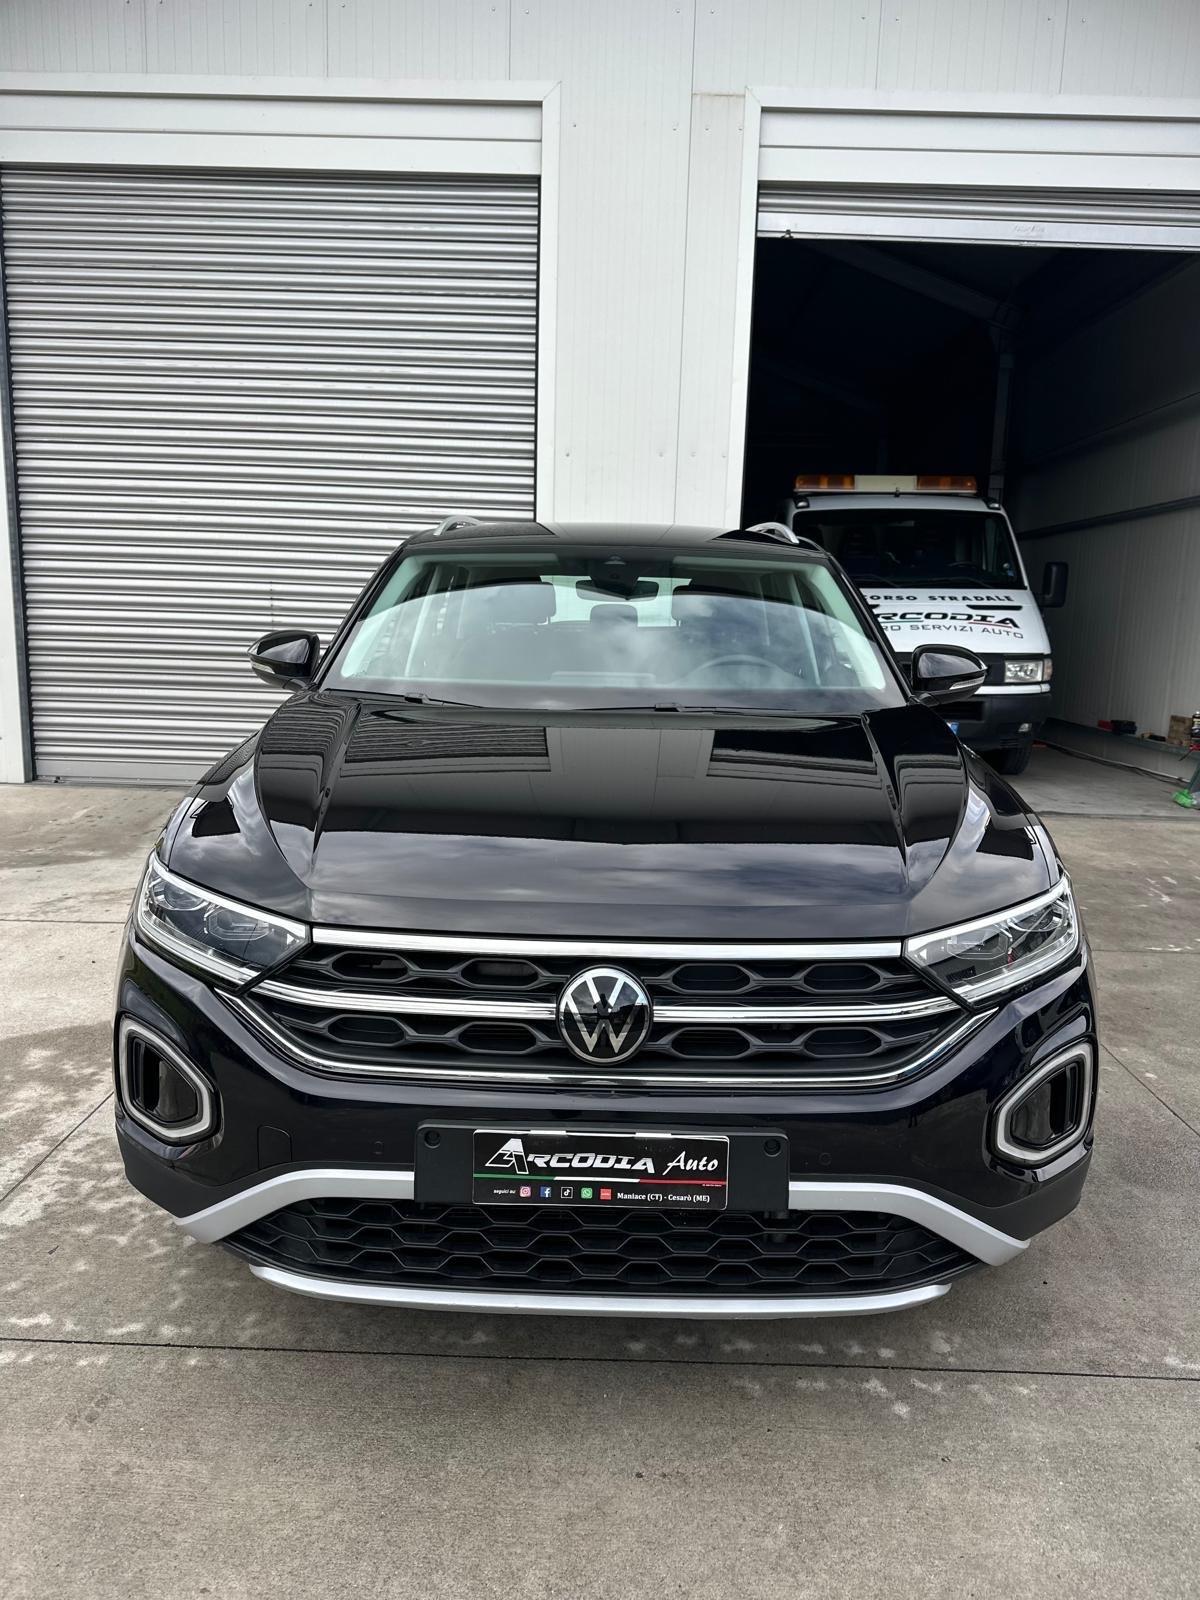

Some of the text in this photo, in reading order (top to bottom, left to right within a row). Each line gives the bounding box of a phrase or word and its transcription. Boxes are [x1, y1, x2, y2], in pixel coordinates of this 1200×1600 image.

[864, 594, 918, 602] ORSO
[874, 612, 1020, 629] RCODIA
[910, 624, 973, 633] SERVIZI
[981, 627, 1024, 639] AUTO
[558, 967, 650, 1062] VW
[485, 1138, 719, 1176] ARCODIA Auto
[617, 1192, 646, 1200] Maniace
[647, 1193, 663, 1201] (CT)
[693, 1194, 710, 1203] (ME)
